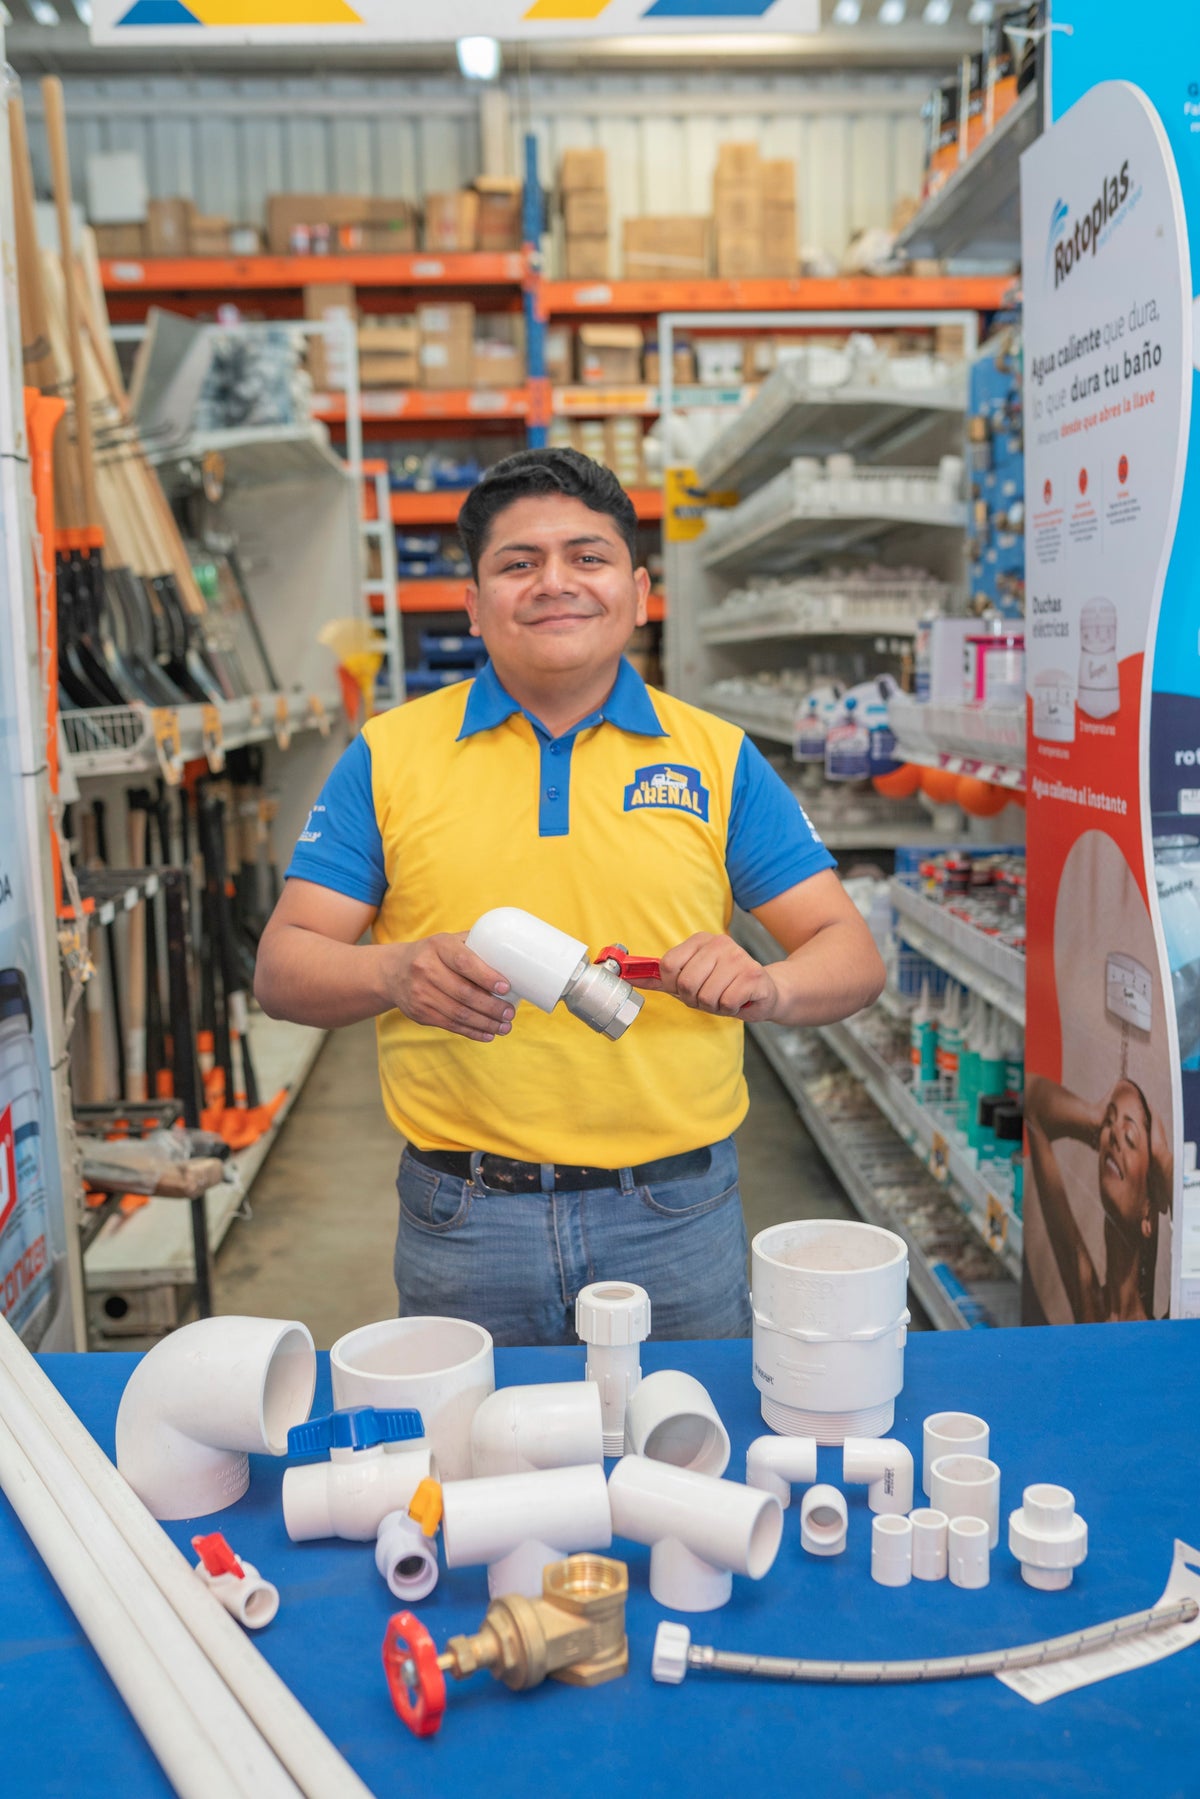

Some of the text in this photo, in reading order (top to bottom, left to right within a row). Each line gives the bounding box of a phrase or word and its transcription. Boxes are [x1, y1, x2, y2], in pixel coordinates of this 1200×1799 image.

[1183, 101, 1200, 116] Fa
[1055, 159, 1129, 289] Rotoplas
[1032, 298, 1160, 387] Agua caliente que dura,
[1045, 387, 1067, 419] que
[1070, 374, 1100, 402] dura
[1104, 362, 1119, 388] tu
[1123, 340, 1162, 380] baño
[1099, 401, 1122, 424] abres
[1123, 395, 1131, 414] la
[1133, 389, 1155, 410] llave
[1032, 595, 1062, 615] Duchas
[631, 783, 703, 815] ARENAL
[1032, 775, 1128, 816] Agua caliente al instante
